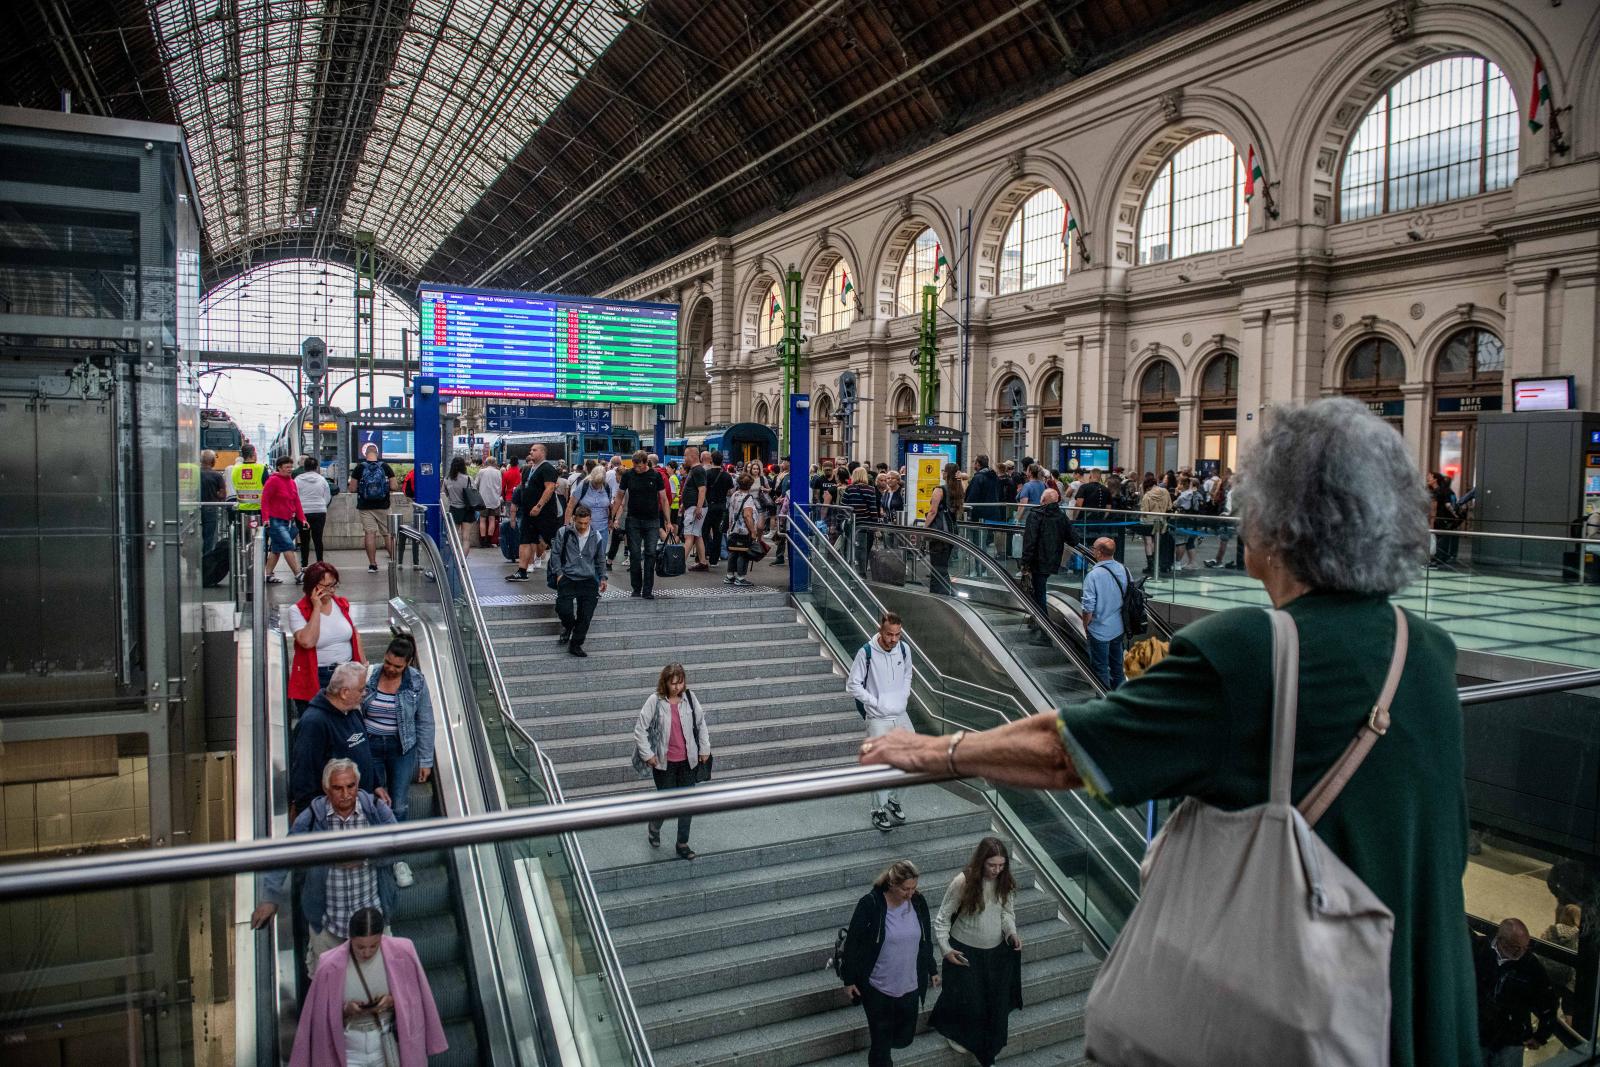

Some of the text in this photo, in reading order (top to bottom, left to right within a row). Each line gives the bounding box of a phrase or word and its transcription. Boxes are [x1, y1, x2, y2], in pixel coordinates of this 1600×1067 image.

[393, 399, 400, 407] 7
[575, 409, 583, 417] 10
[928, 418, 934, 426] 8
[366, 430, 375, 441] 7
[912, 443, 919, 453] 8
[1071, 449, 1077, 458] 9
